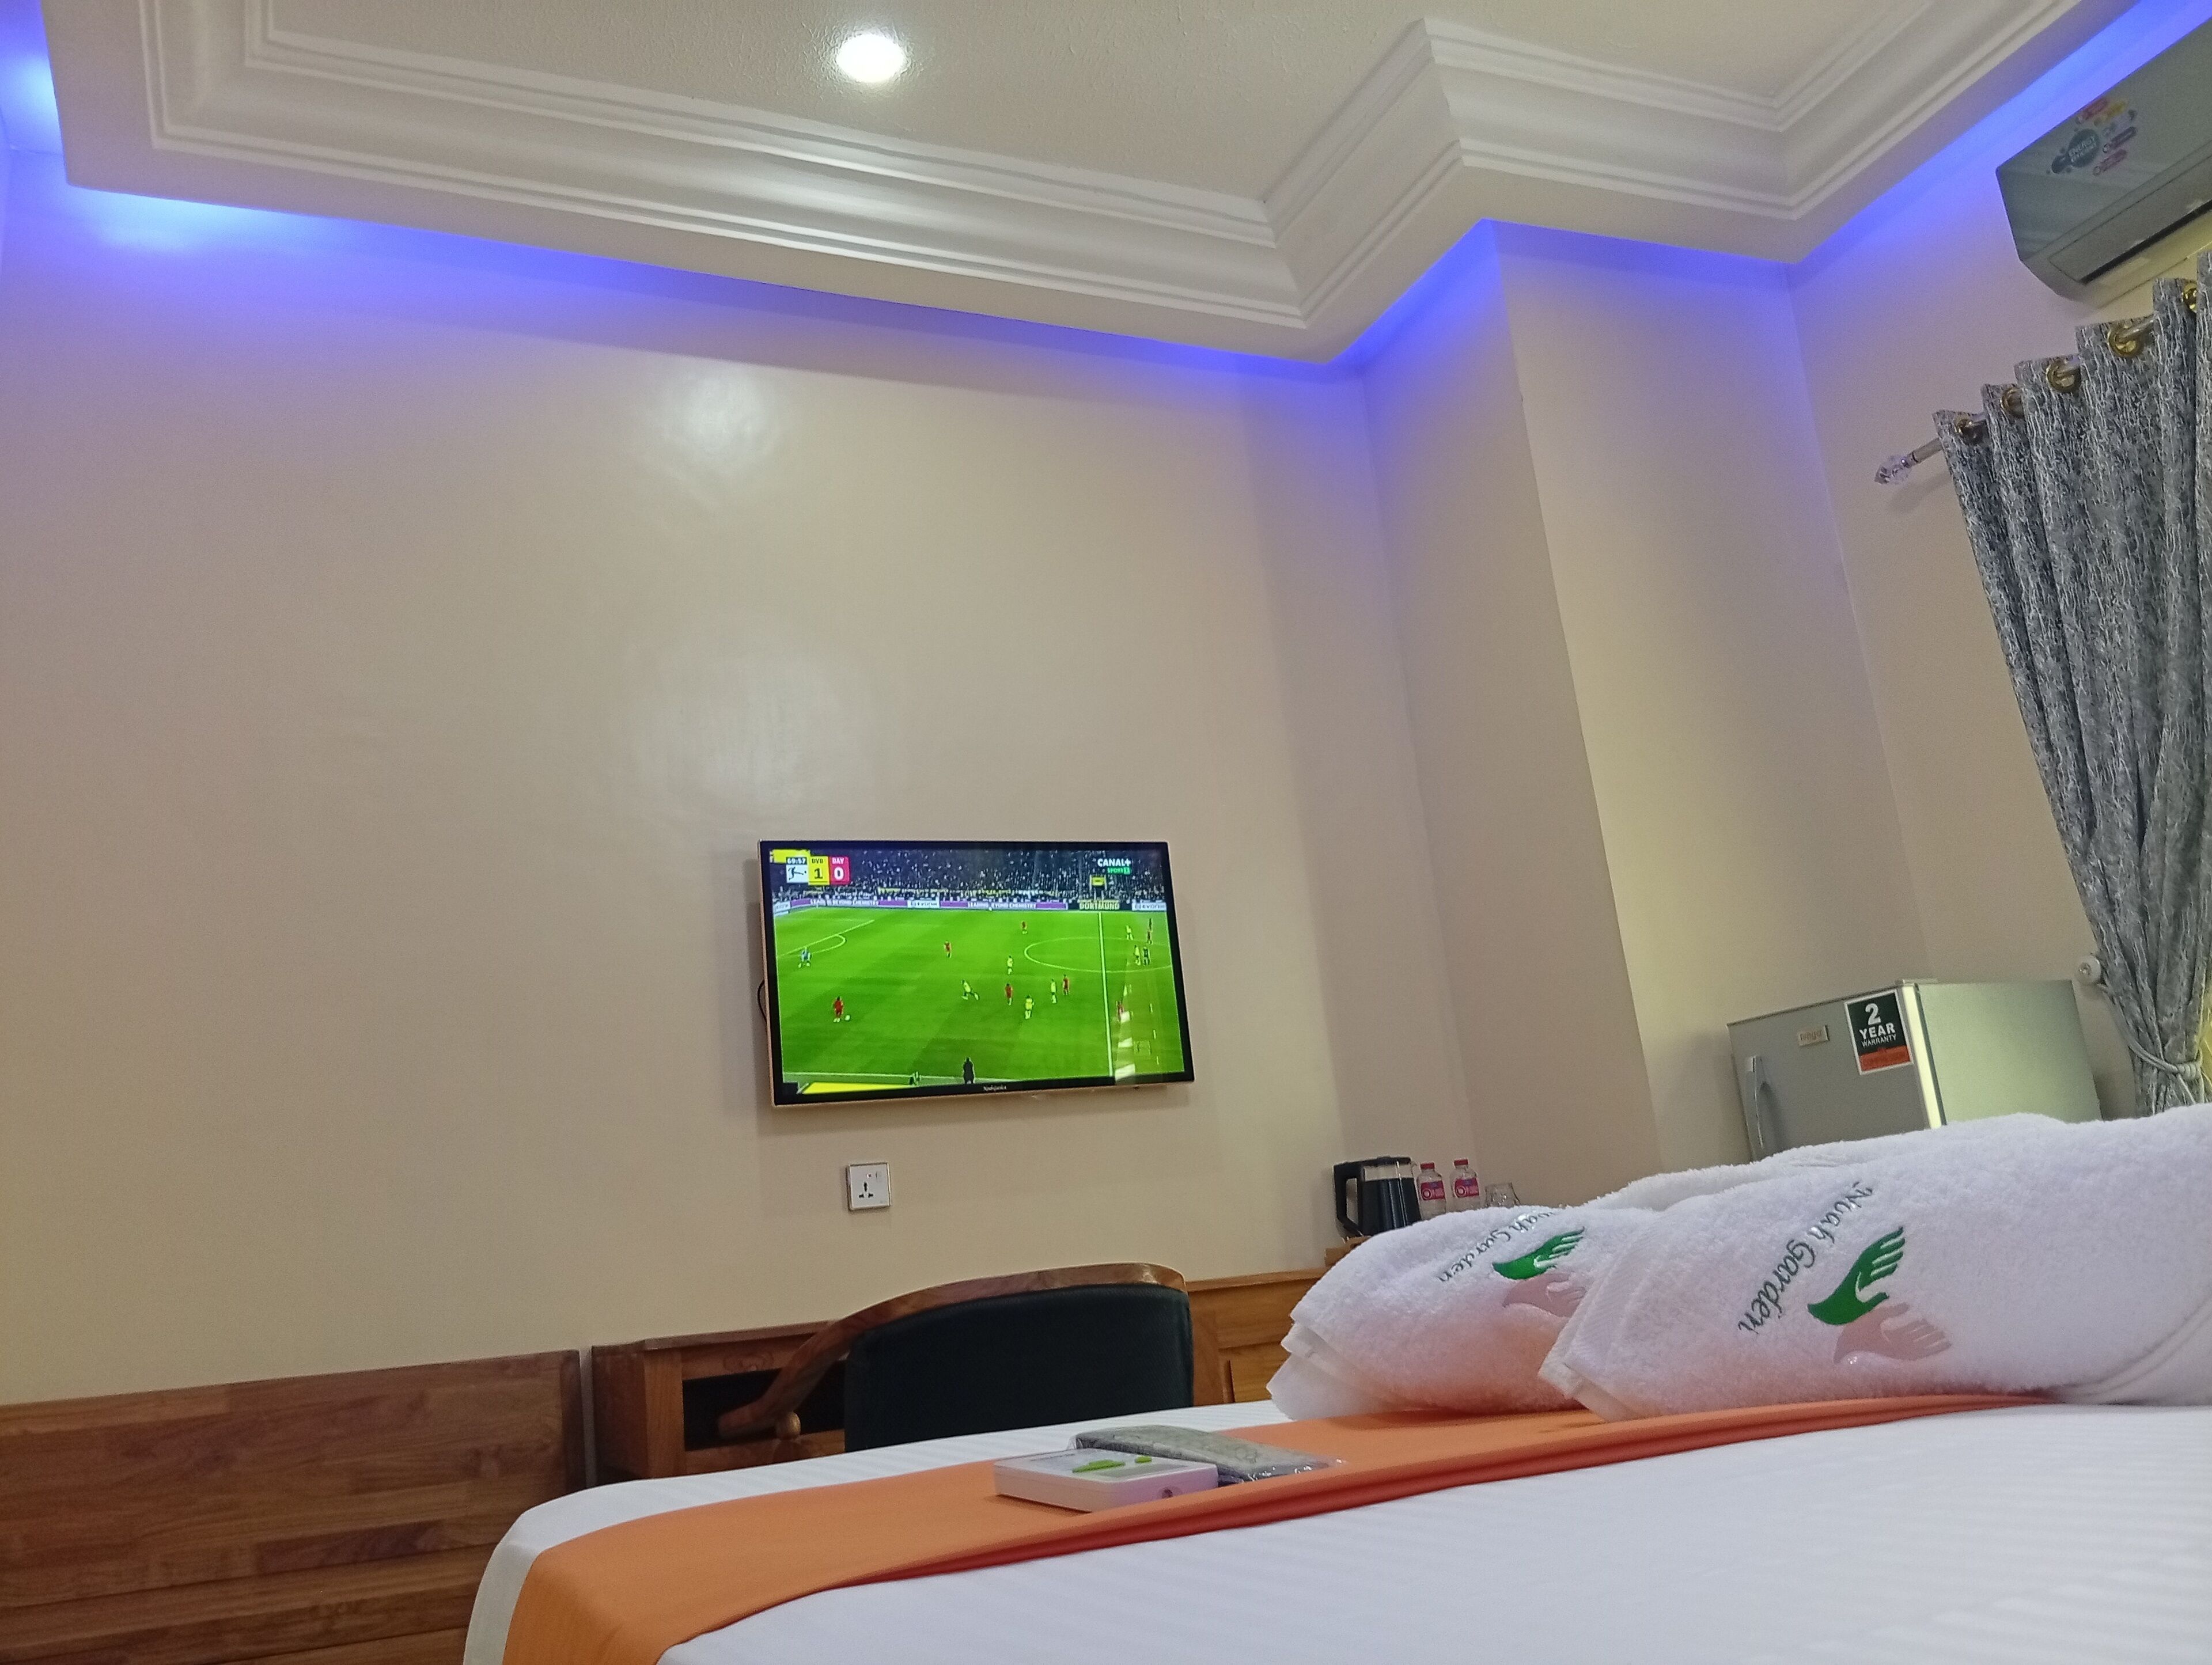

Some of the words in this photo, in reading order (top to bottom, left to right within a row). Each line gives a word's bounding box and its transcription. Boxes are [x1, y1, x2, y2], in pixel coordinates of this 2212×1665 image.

[1097, 858, 1132, 867] CANAL+
[814, 867, 823, 880] 1
[834, 866, 844, 880] 0
[1865, 1003, 1881, 1025] 2
[1859, 1022, 1896, 1040] YEAR
[1861, 1033, 1896, 1048] WARRANTY
[1737, 1239, 1815, 1334] Garden
